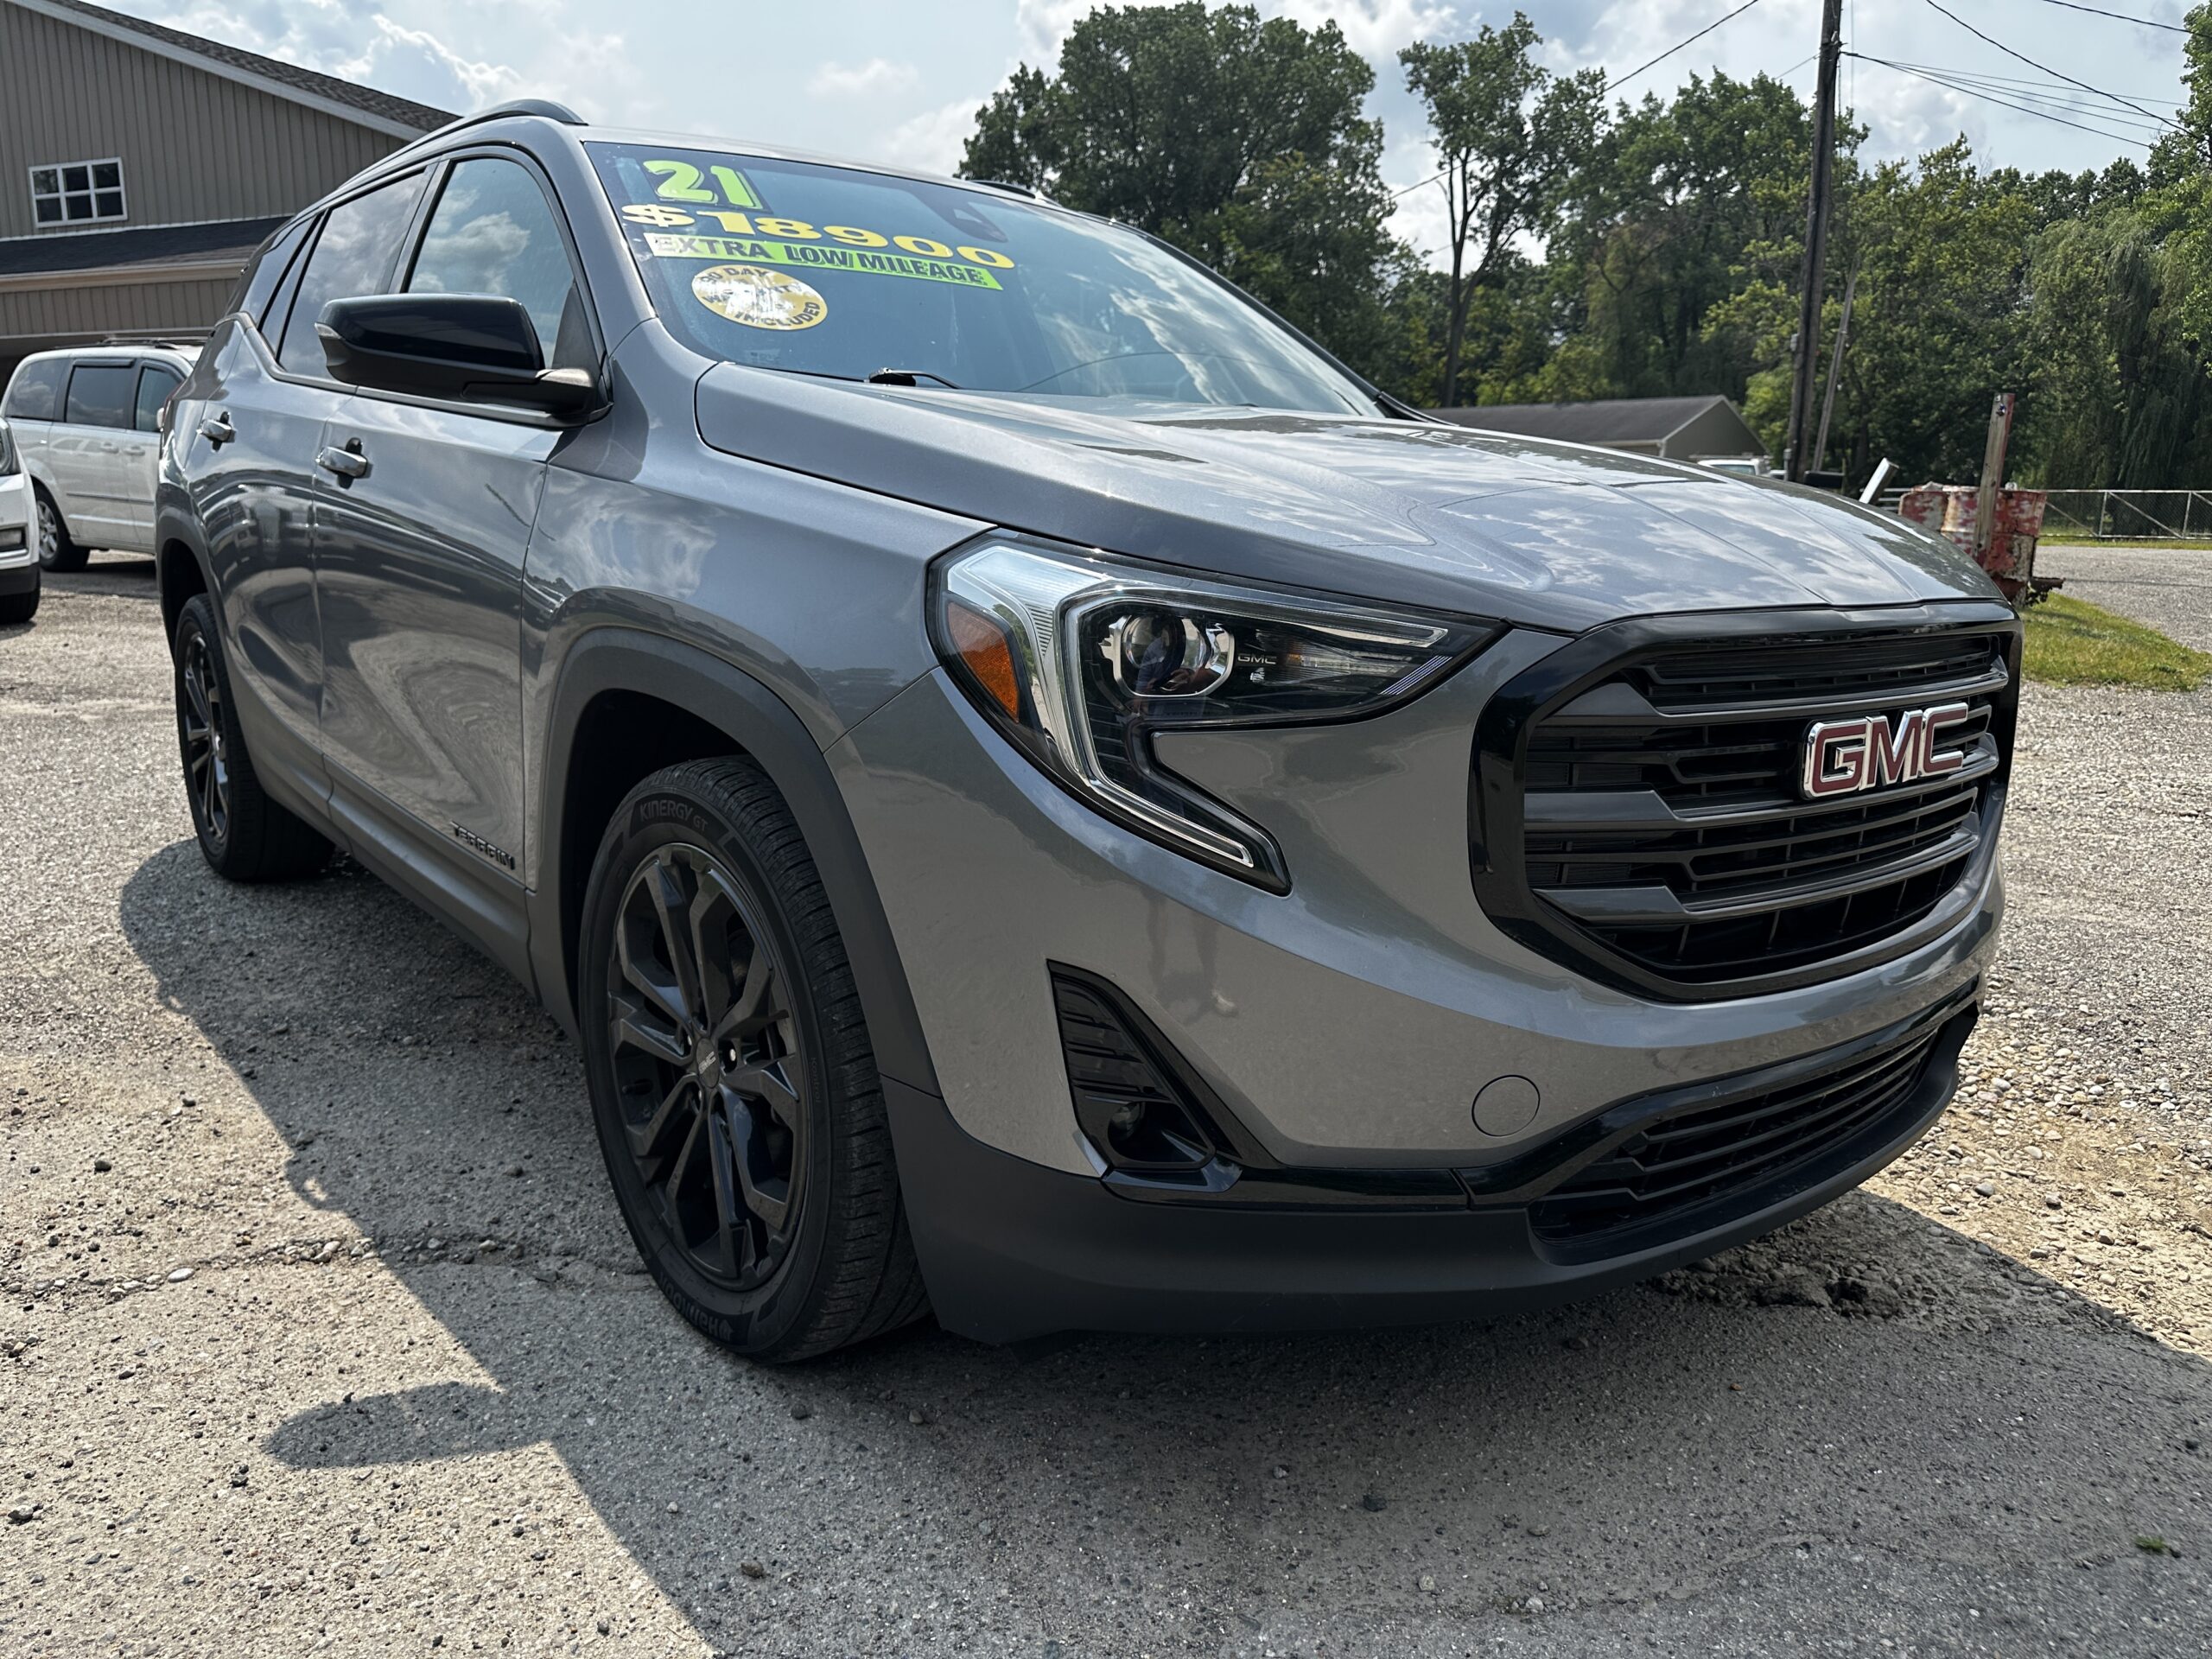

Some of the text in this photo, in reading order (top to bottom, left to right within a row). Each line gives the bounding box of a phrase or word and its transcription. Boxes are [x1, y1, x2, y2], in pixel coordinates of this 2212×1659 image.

[643, 160, 764, 210] 21
[621, 203, 1015, 269] $18900
[653, 237, 988, 287] EXTRA LOW MILEAGE
[723, 267, 772, 277] DAY
[735, 302, 820, 327] INCLUDED
[1237, 653, 1277, 664] GMC
[1803, 702, 1968, 798] GMC
